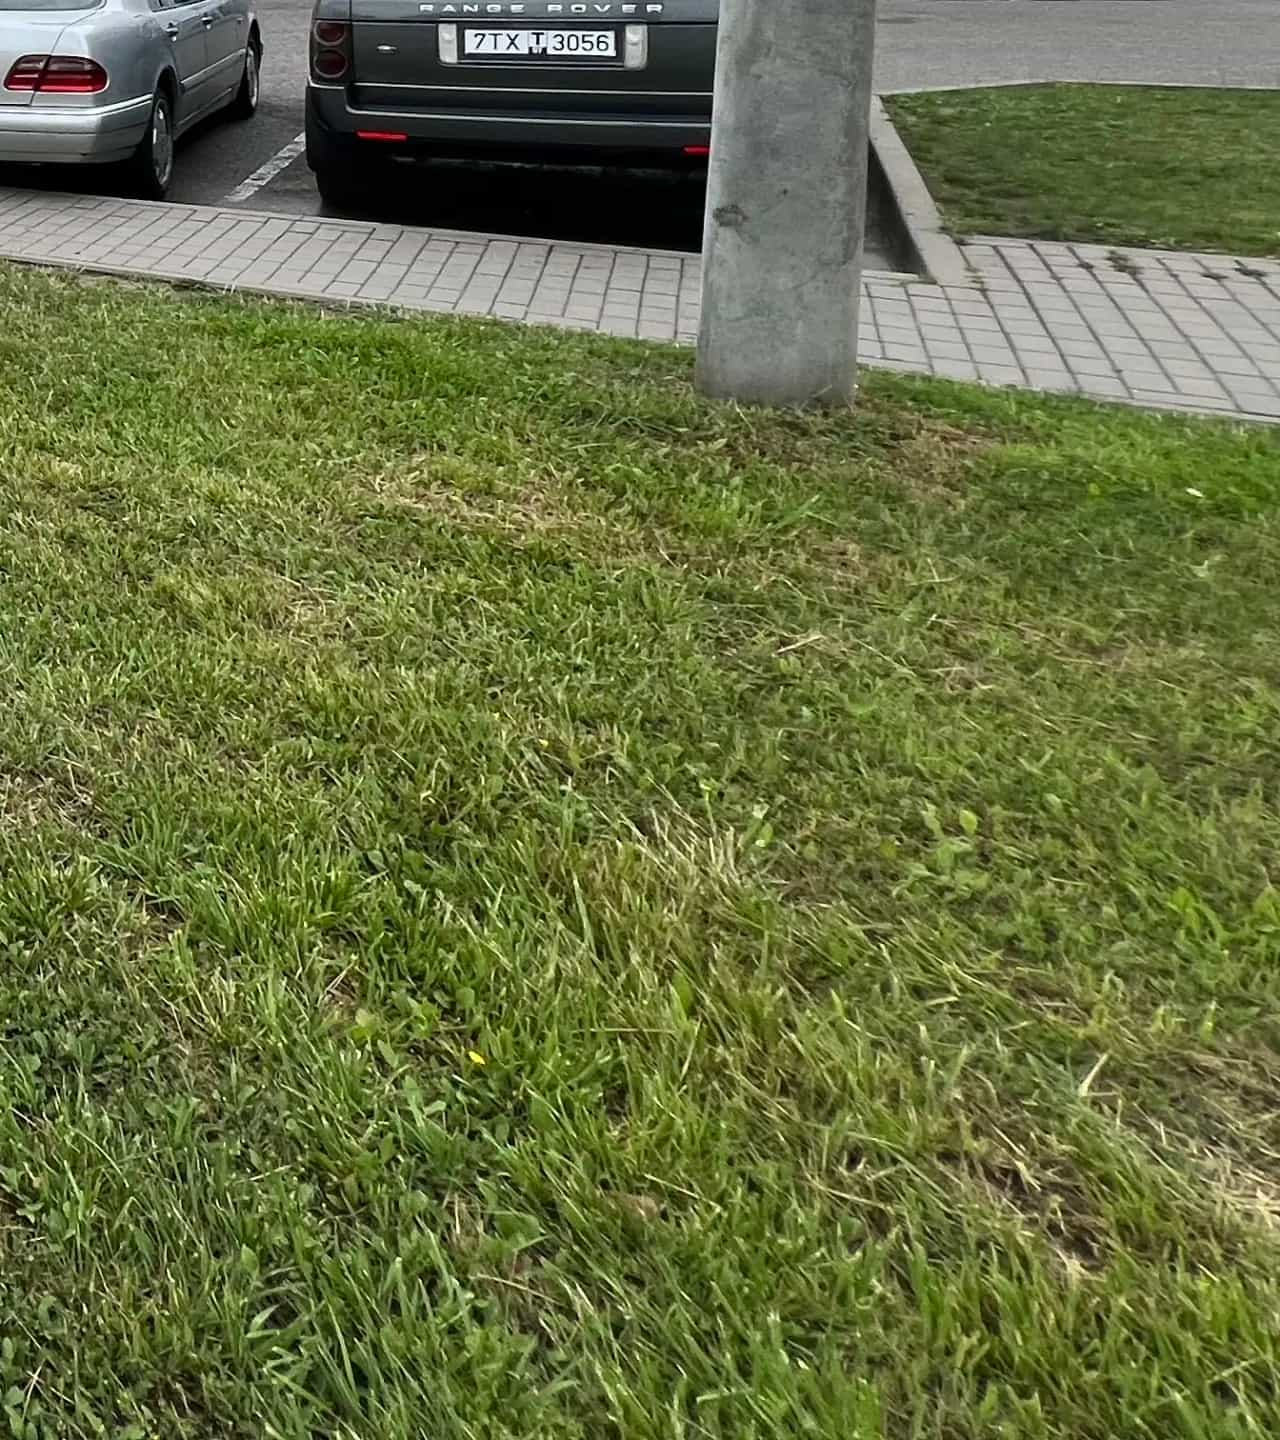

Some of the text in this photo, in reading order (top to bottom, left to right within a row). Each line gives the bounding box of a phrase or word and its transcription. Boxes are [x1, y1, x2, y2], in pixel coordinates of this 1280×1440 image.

[419, 3, 663, 13] RANGE ROVER
[552, 33, 609, 52] 3056
